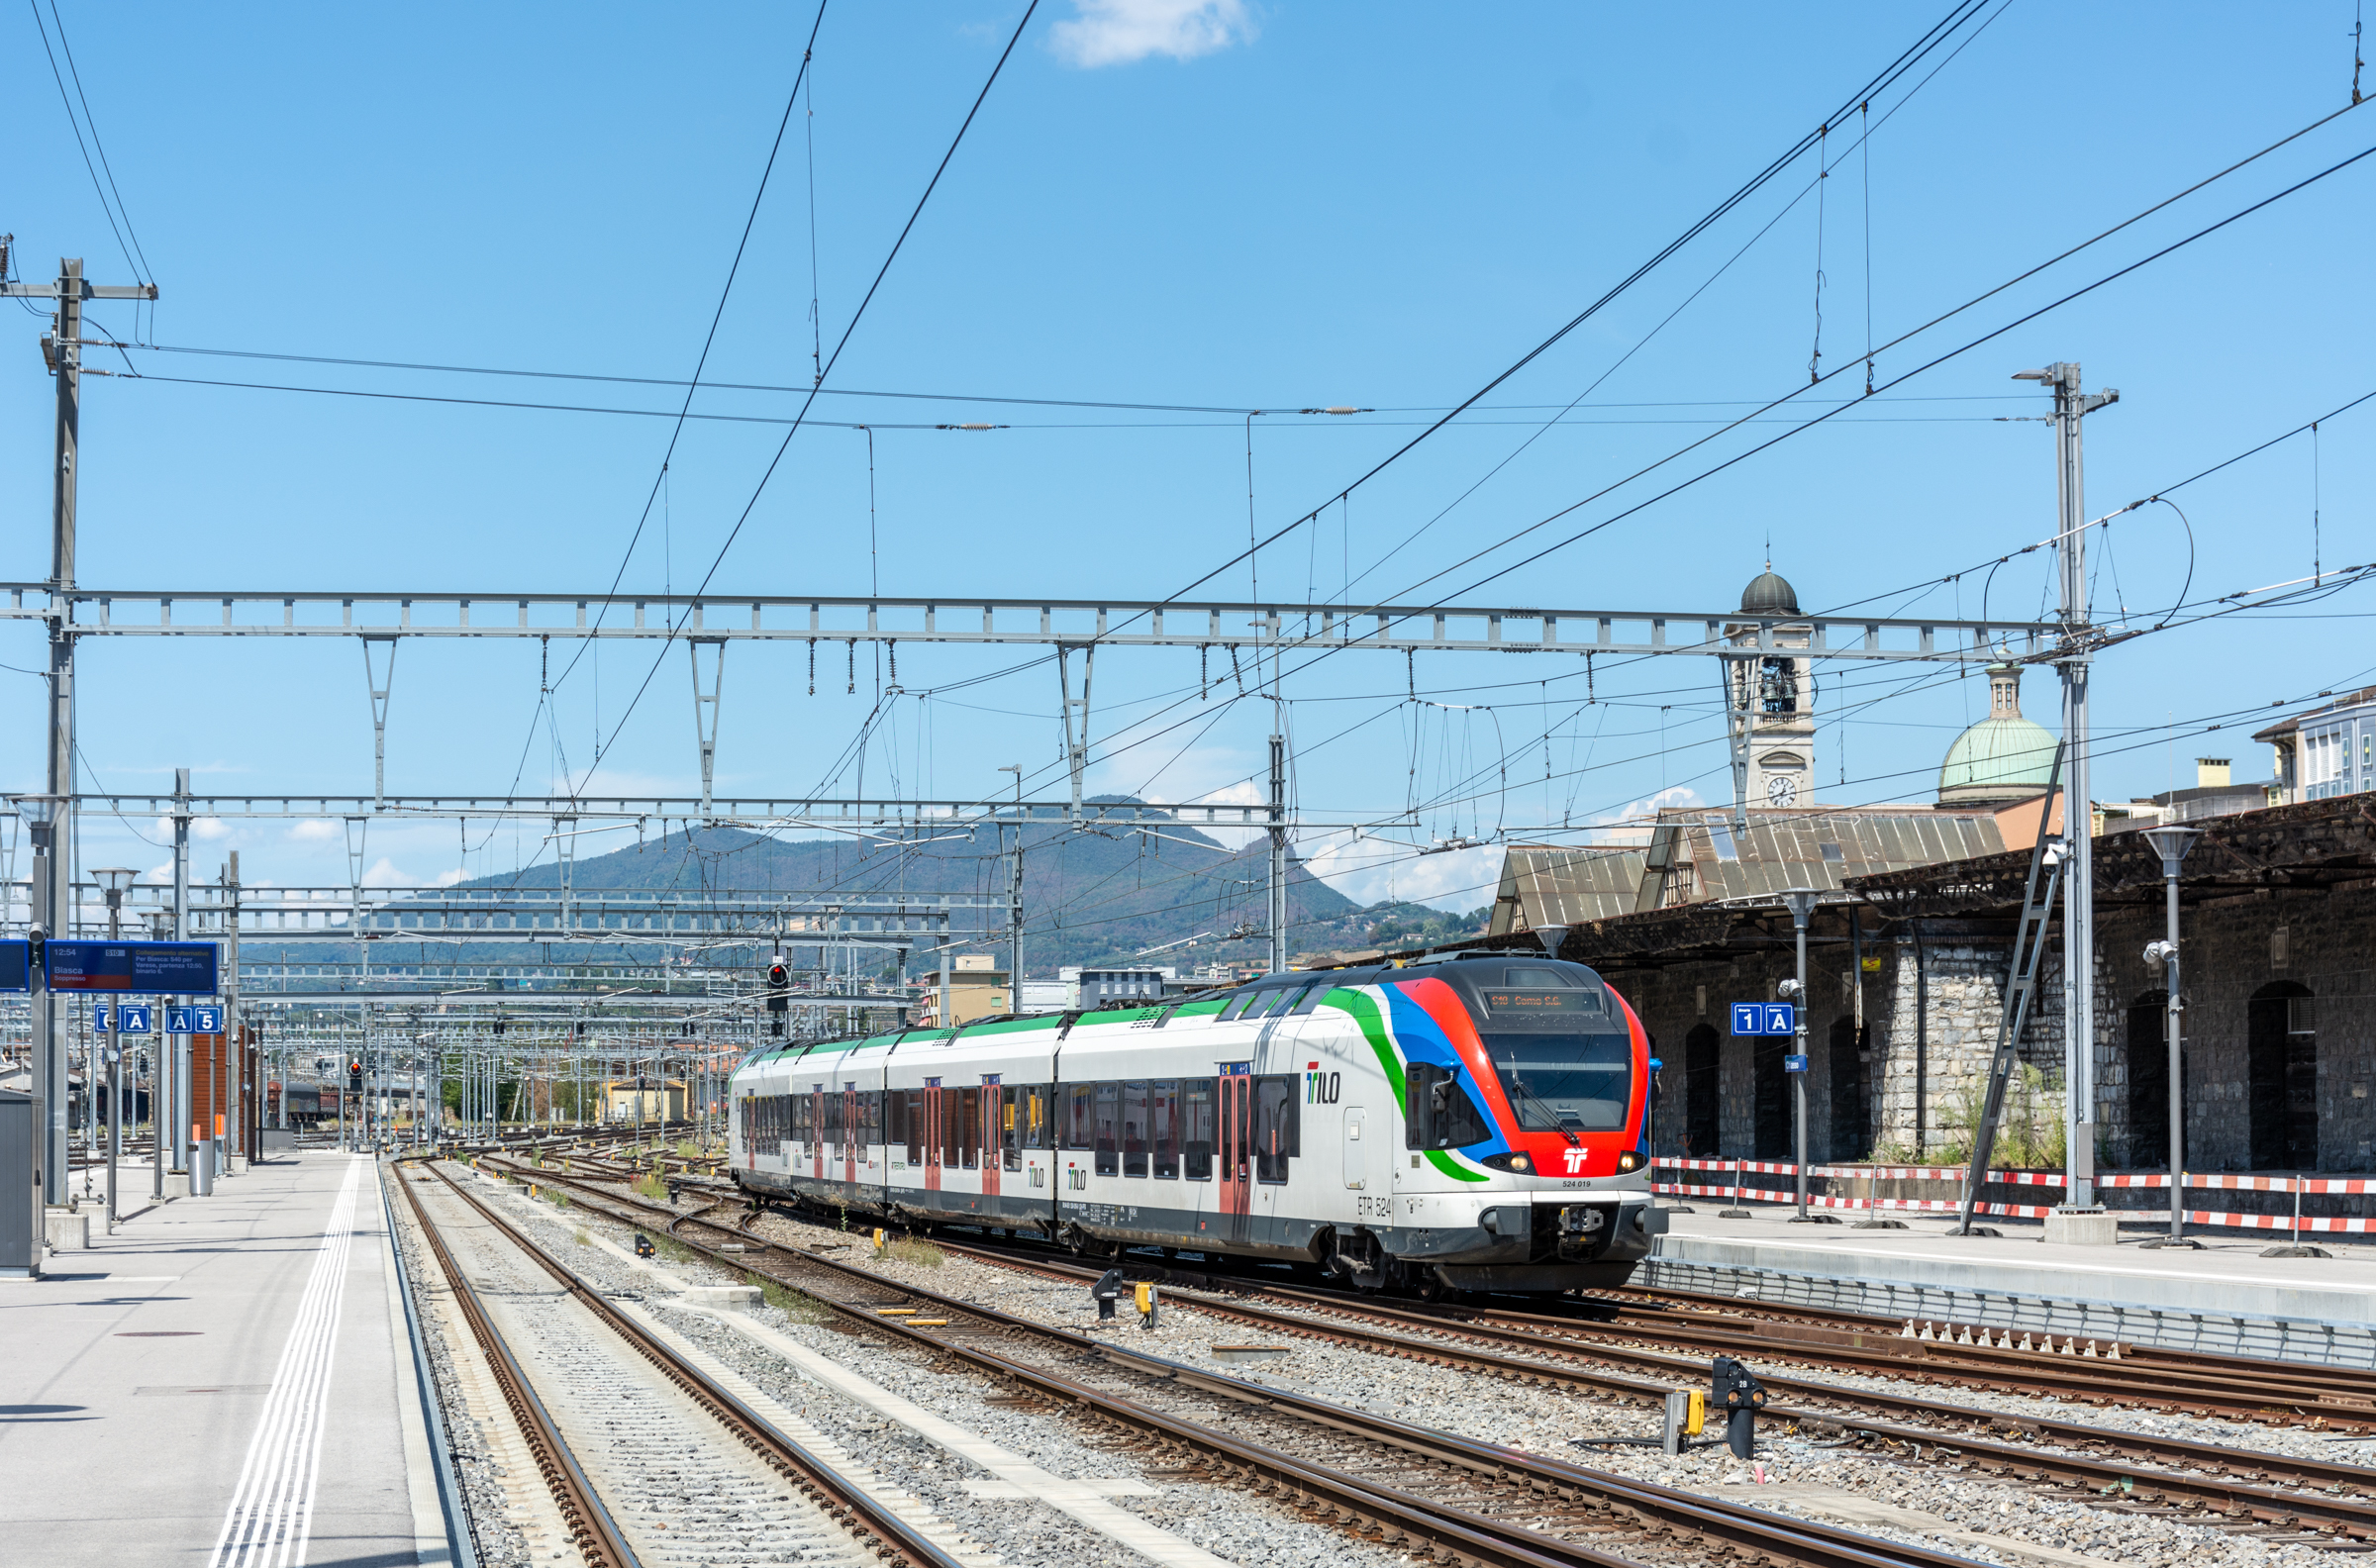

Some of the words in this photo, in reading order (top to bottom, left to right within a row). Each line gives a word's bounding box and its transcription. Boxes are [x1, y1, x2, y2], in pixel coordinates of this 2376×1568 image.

[54, 966, 83, 975] Biasca
[1492, 995, 1509, 1005] S10
[1515, 996, 1542, 1006] Como
[130, 1014, 144, 1029] A
[173, 1015, 187, 1029] A
[202, 1015, 213, 1029] 5
[1743, 1013, 1752, 1029] 1
[1772, 1014, 1787, 1029] A
[1358, 1196, 1373, 1216] ETR
[1376, 1198, 1391, 1218] 524
